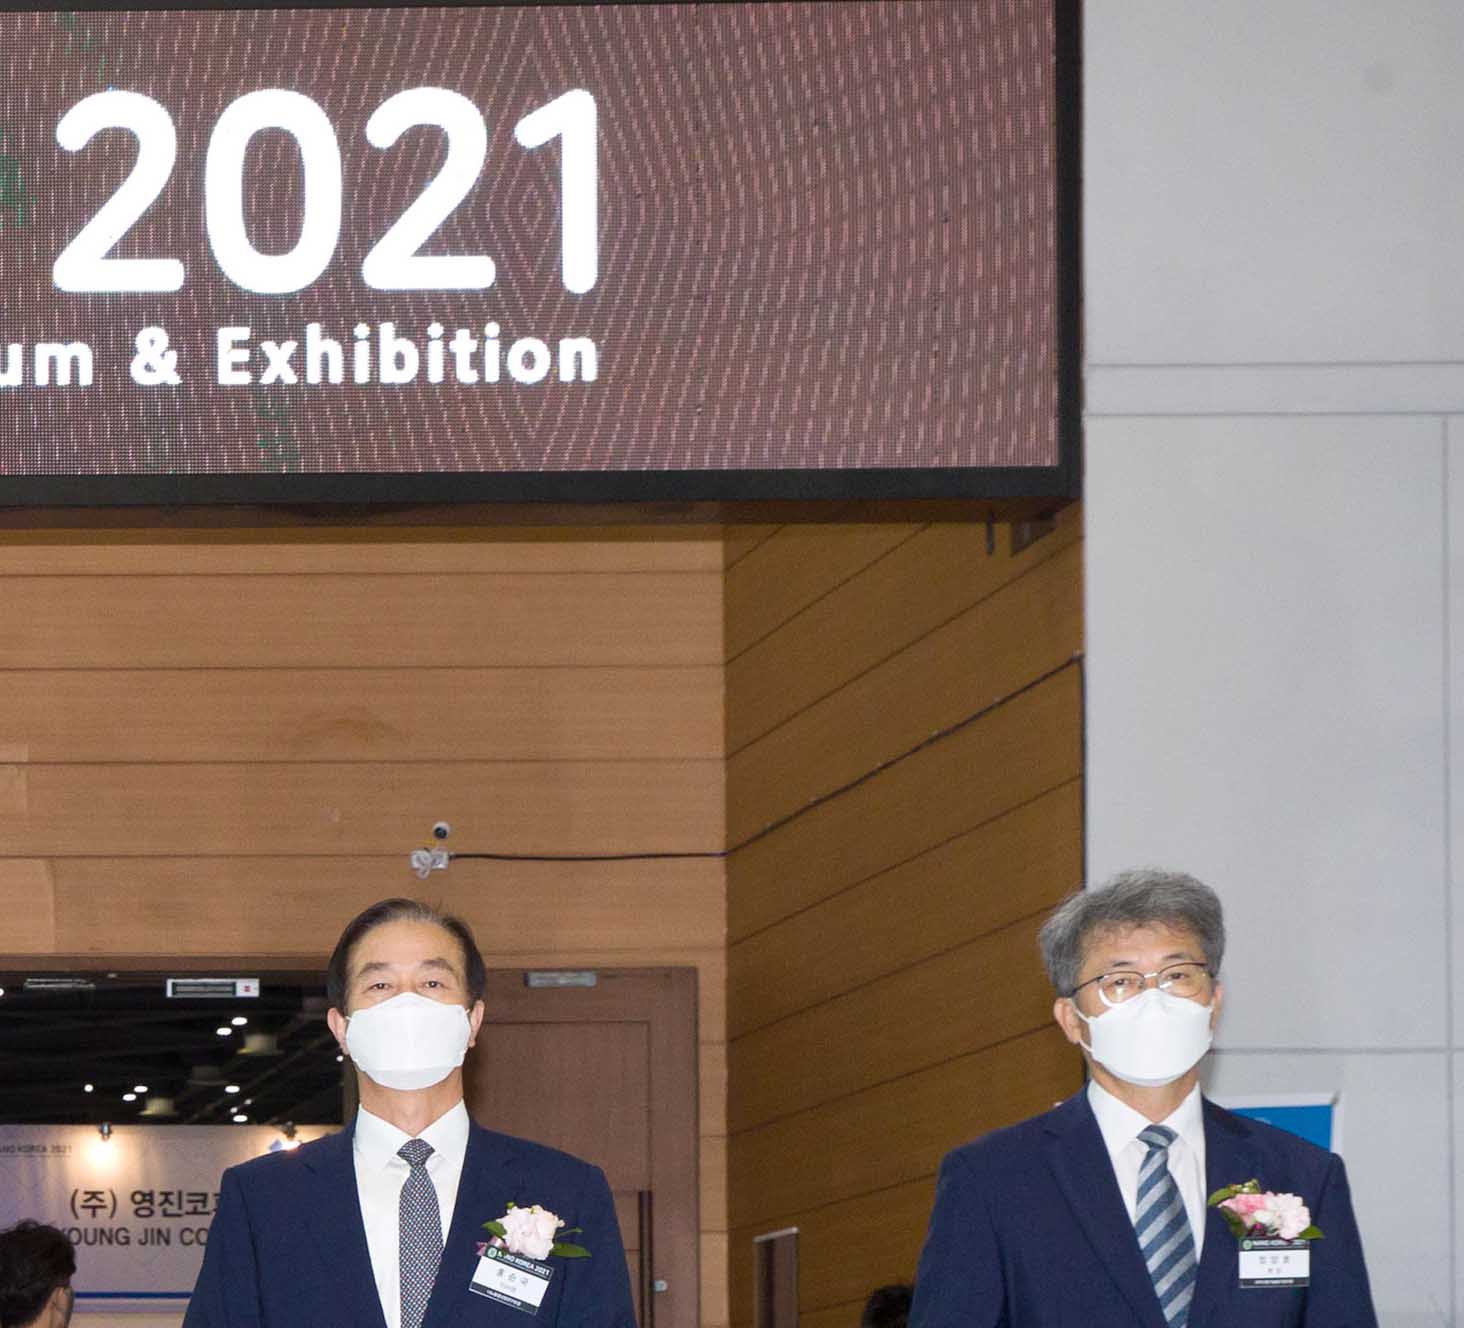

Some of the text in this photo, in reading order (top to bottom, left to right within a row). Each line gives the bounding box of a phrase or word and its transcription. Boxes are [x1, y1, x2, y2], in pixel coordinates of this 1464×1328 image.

[53, 88, 597, 294] 2021
[130, 327, 180, 387] &
[217, 322, 598, 385] Exhibition
[70, 1189, 117, 1219] (주)
[64, 1227, 130, 1247] OUNG
[138, 1227, 170, 1247] JIN
